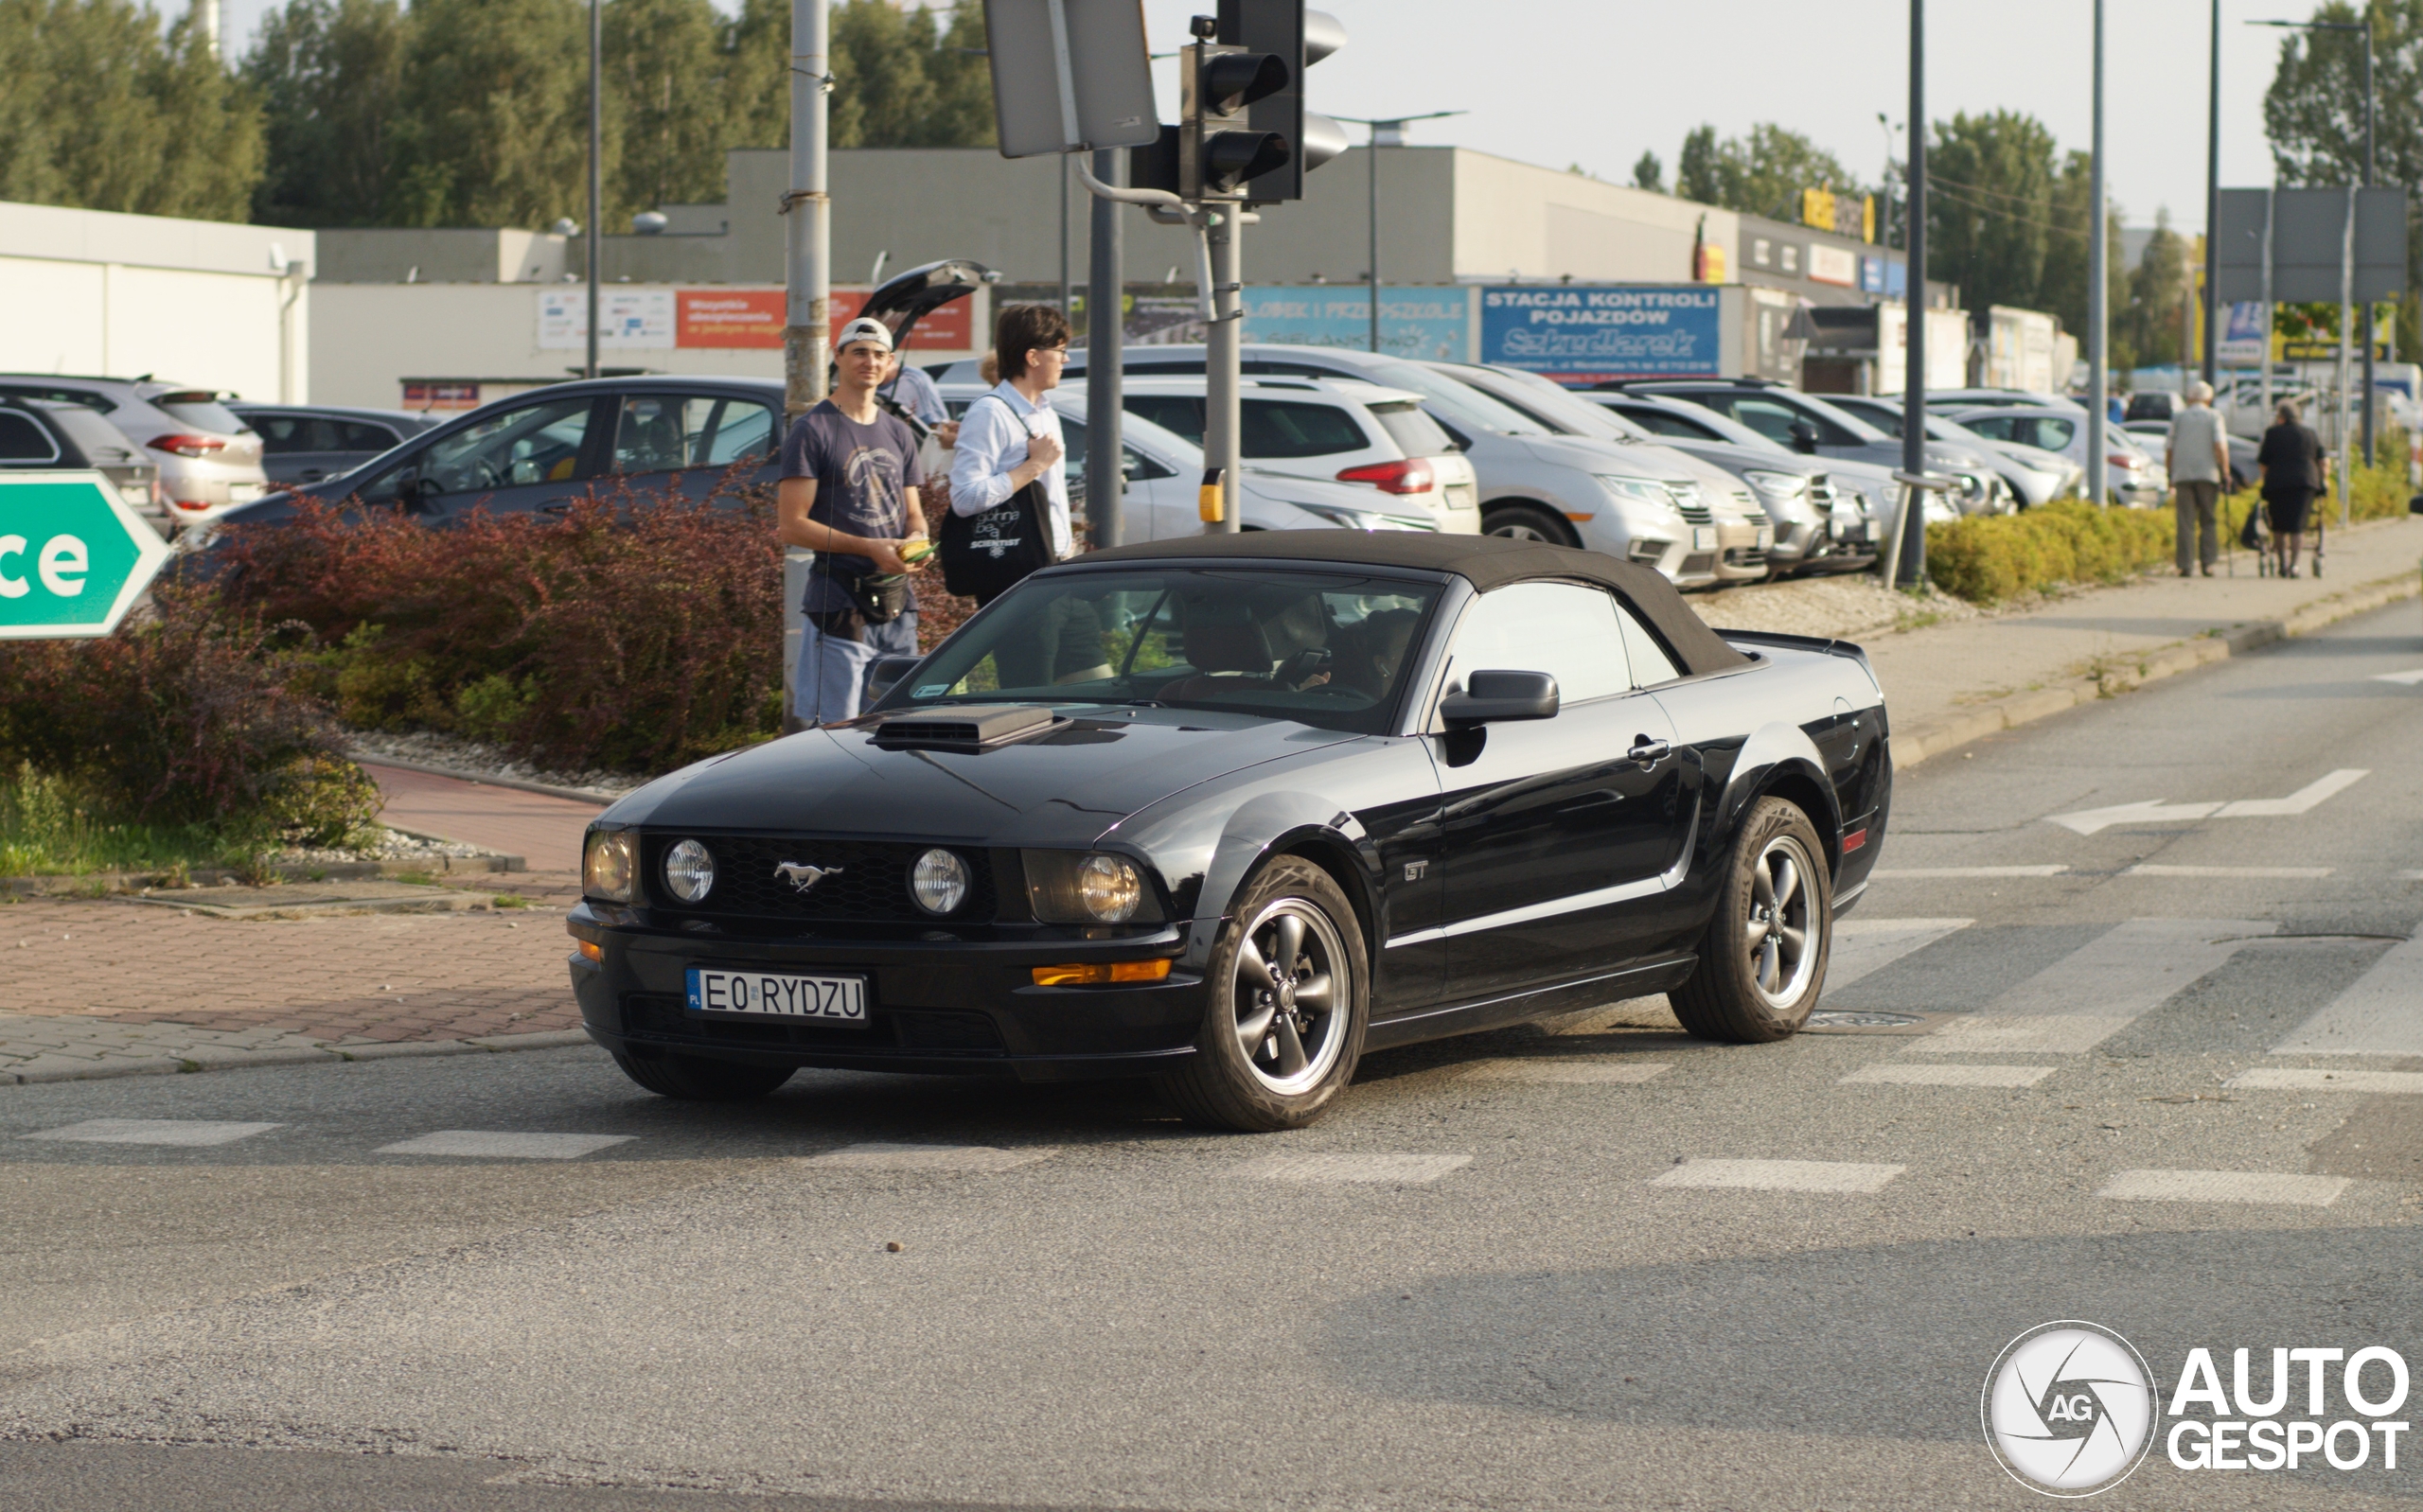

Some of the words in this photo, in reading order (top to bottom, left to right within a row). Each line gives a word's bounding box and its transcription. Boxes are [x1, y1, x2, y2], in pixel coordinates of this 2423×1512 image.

[1486, 292, 1582, 308] STACJA
[1588, 292, 1716, 308] KONTROLI
[1530, 308, 1670, 325] POJAZDÓW
[977, 511, 1019, 525] gonna
[976, 522, 994, 533] be
[969, 538, 1021, 549] SCIENTIST
[1405, 860, 1429, 881] GT
[690, 994, 699, 1005] PL
[761, 977, 861, 1018] RYDZU
